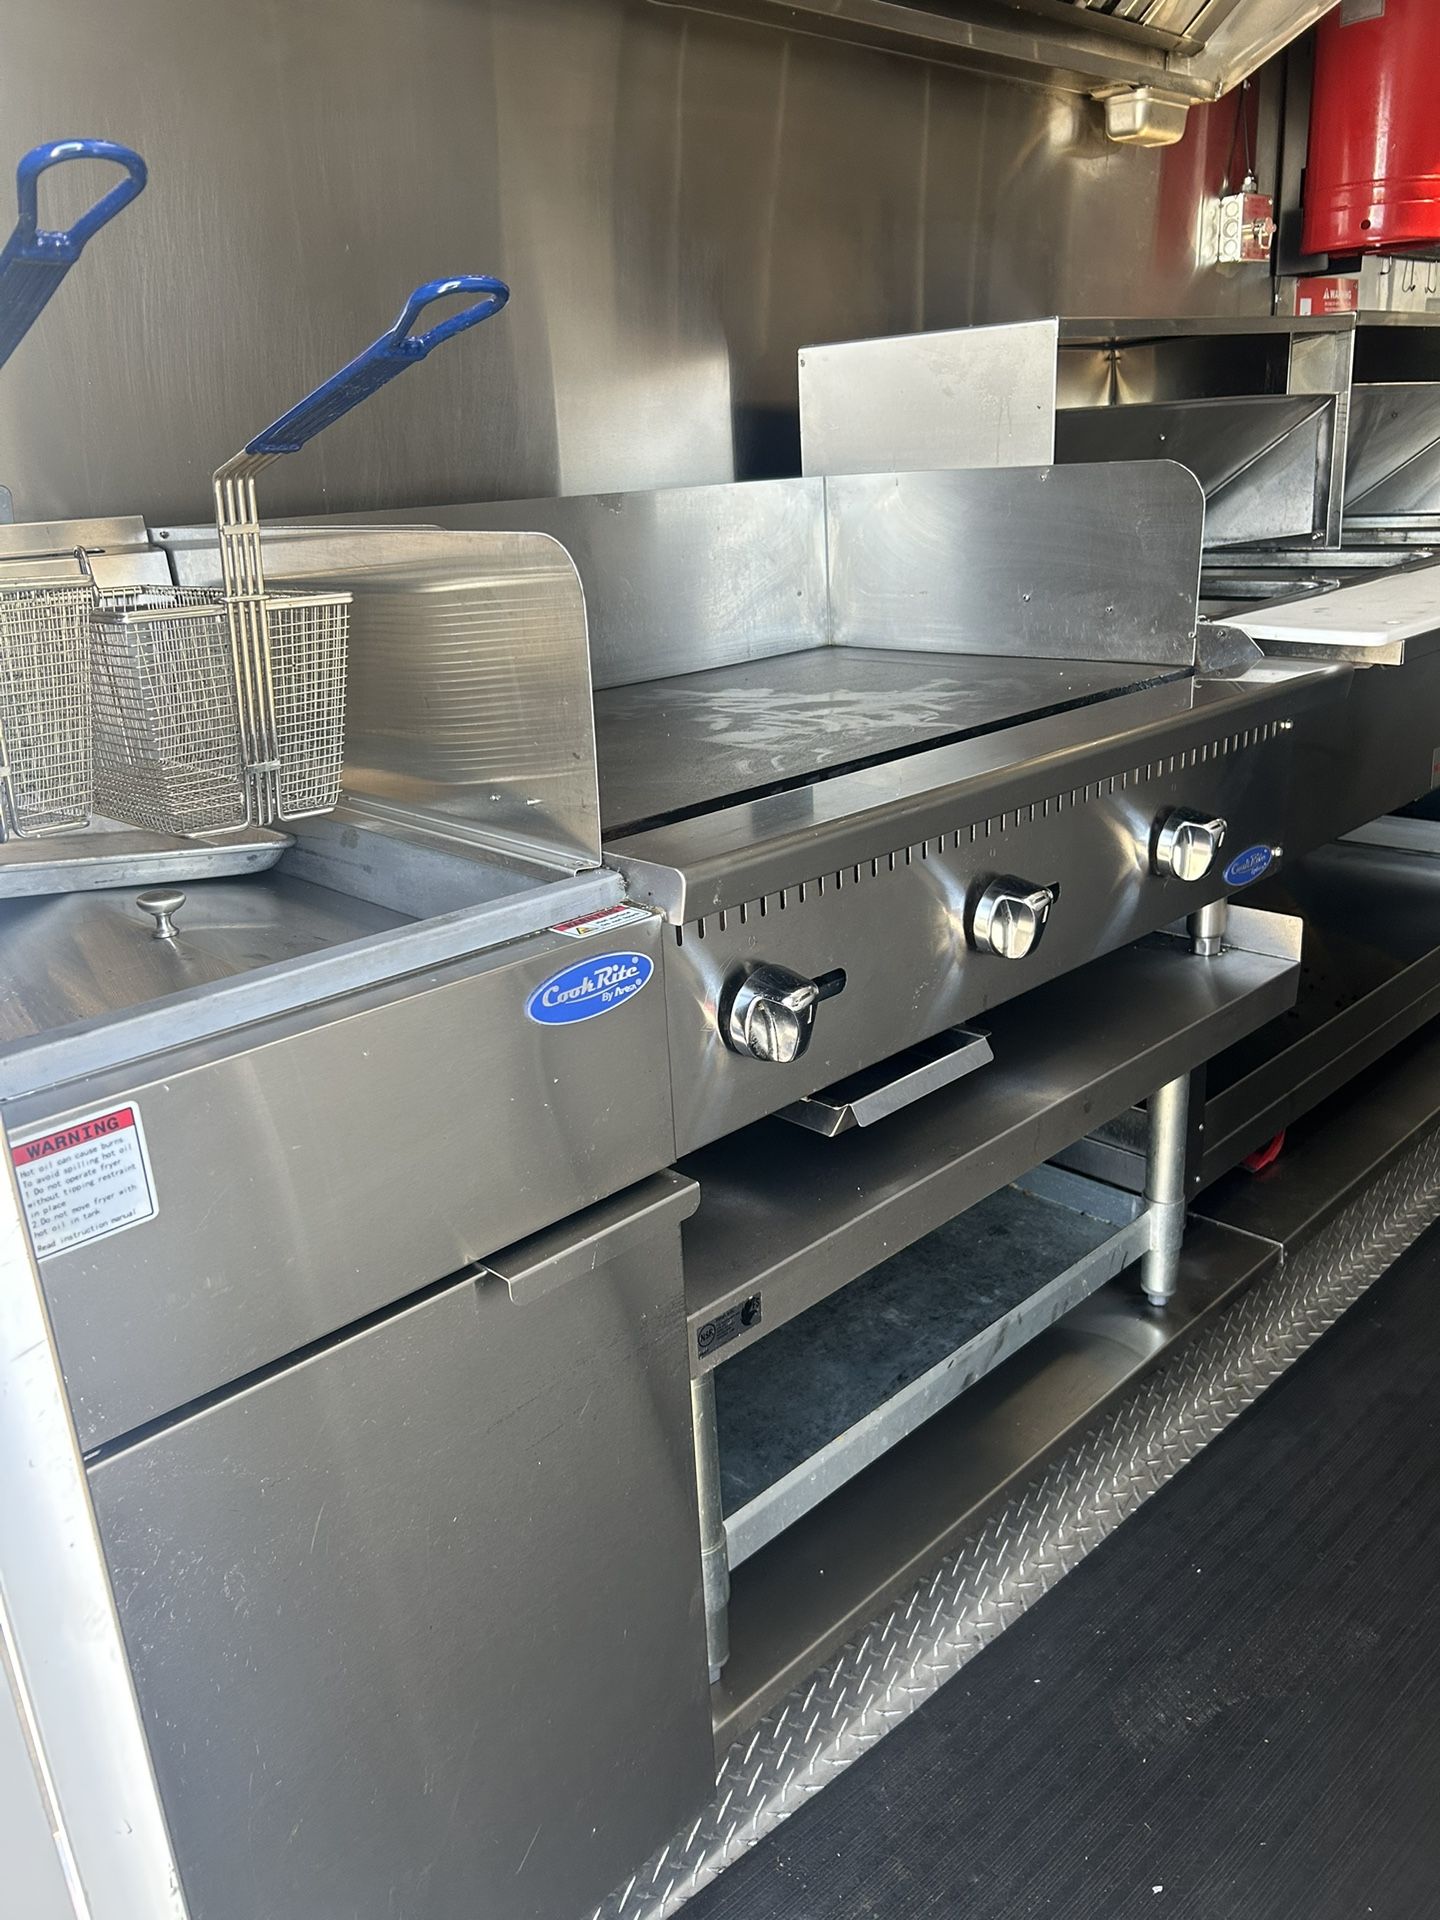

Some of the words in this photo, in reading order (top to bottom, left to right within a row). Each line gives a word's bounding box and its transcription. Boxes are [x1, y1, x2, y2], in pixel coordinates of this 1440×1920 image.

[602, 992, 614, 1002] By
[26, 1117, 119, 1159] WARNING
[20, 1169, 34, 1178] Hot
[38, 1162, 52, 1172] oil
[75, 1147, 96, 1158] cause
[101, 1138, 123, 1148] burns
[22, 1179, 32, 1188] To
[36, 1171, 59, 1183] avoid
[64, 1158, 98, 1174] spilling
[102, 1150, 115, 1159] hot
[119, 1144, 131, 1153] oil
[65, 1169, 96, 1185] operate
[100, 1160, 121, 1172] fryer
[28, 1192, 58, 1208] without
[64, 1181, 94, 1196] tipping
[98, 1164, 136, 1181] restraint
[72, 1204, 89, 1212] move
[94, 1194, 114, 1206] fryer
[119, 1185, 136, 1194] with
[34, 1229, 46, 1238] hot
[52, 1222, 64, 1231] oil
[84, 1209, 99, 1218] tank
[43, 1202, 65, 1214] place
[37, 1241, 55, 1251] Read
[60, 1221, 108, 1242] instruction
[111, 1210, 135, 1223] manual
